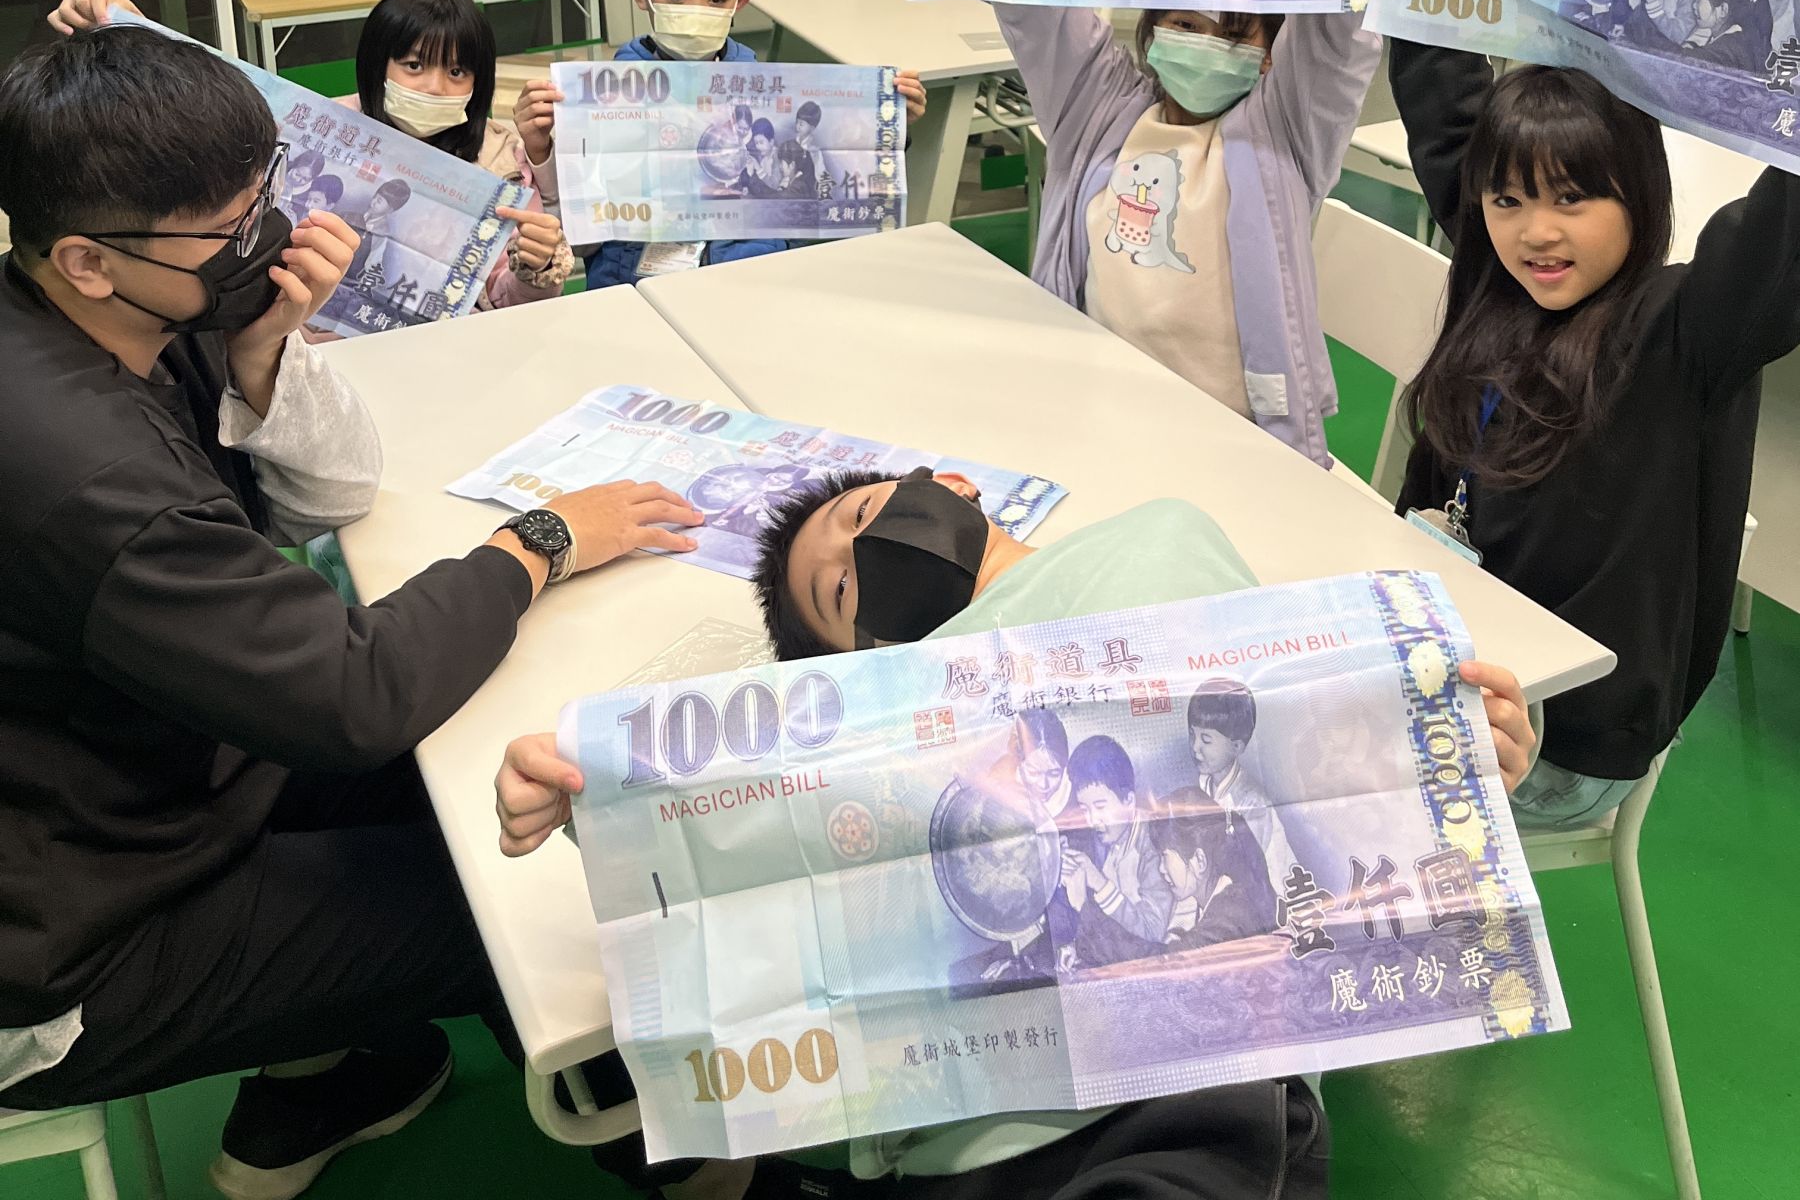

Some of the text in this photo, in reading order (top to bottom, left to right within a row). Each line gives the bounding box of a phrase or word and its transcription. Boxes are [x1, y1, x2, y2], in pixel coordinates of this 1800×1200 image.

[578, 65, 671, 104] 1000
[592, 111, 642, 120] MAGICIAN
[396, 163, 449, 194] MAGICIAN
[592, 202, 652, 223] 1000
[606, 391, 732, 435] 1000
[942, 637, 1143, 700] 魔術道具
[1187, 631, 1353, 670] MAGICIAN BILL
[990, 683, 1113, 720] 魔術銀行
[617, 670, 844, 789] 1000
[659, 769, 831, 822] MAGICIAN BILL
[1276, 844, 1490, 960] 壹仟圓
[1330, 947, 1493, 1013] 魔術鈔票
[684, 1028, 839, 1103] 1000
[902, 1026, 1059, 1067] 魔術城堡印製發行
